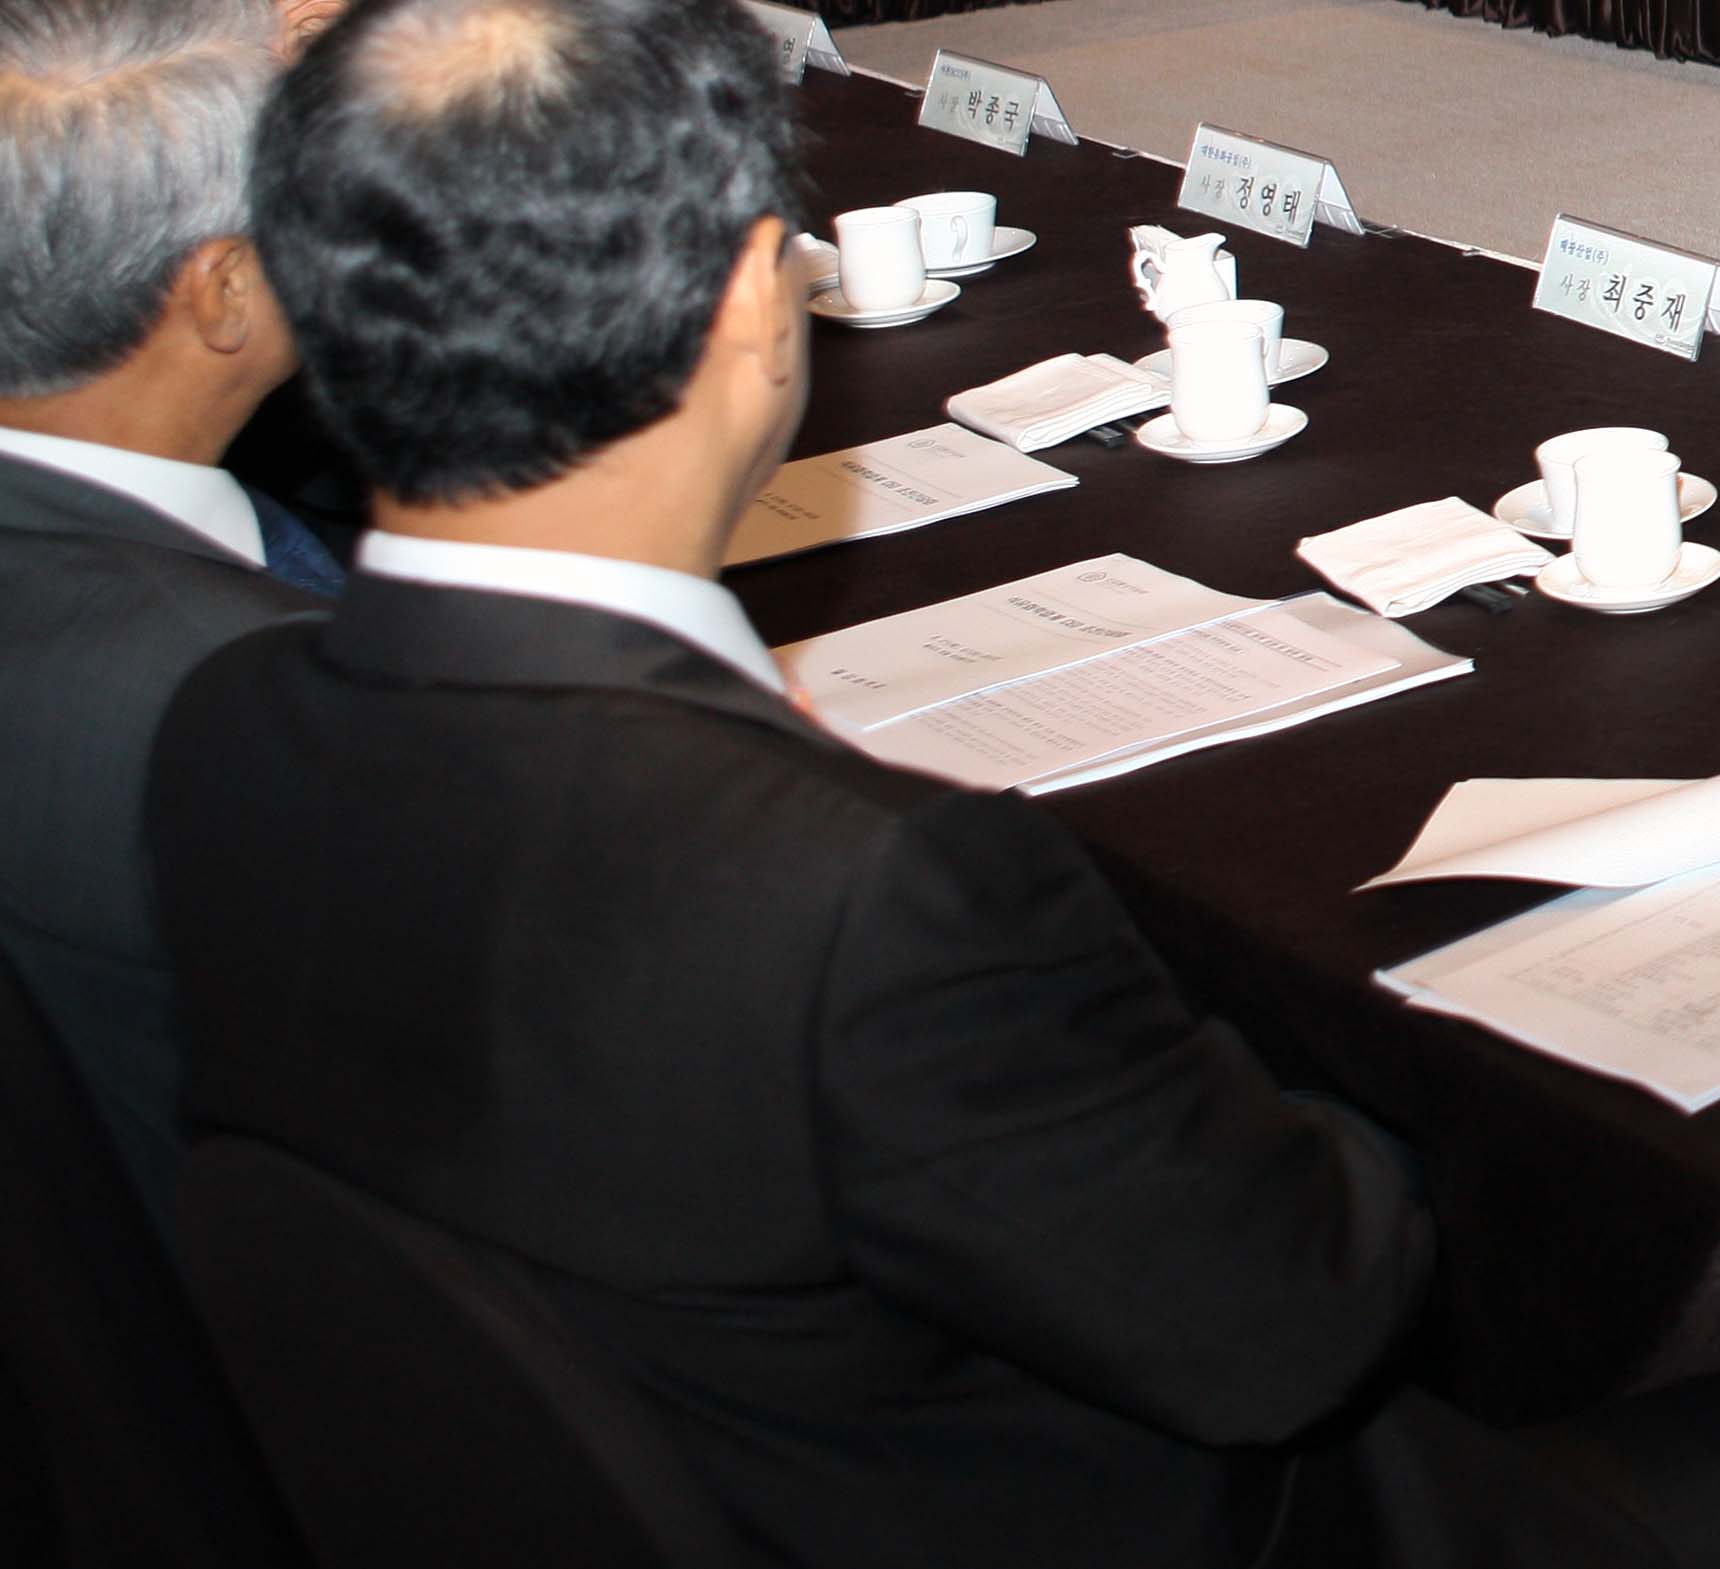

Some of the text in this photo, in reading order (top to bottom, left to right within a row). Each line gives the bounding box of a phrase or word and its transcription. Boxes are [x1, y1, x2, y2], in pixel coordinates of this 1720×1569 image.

[967, 89, 1020, 132] 박종국
[1236, 176, 1302, 225] 정영태
[1559, 272, 1687, 333] 사장 최중재
